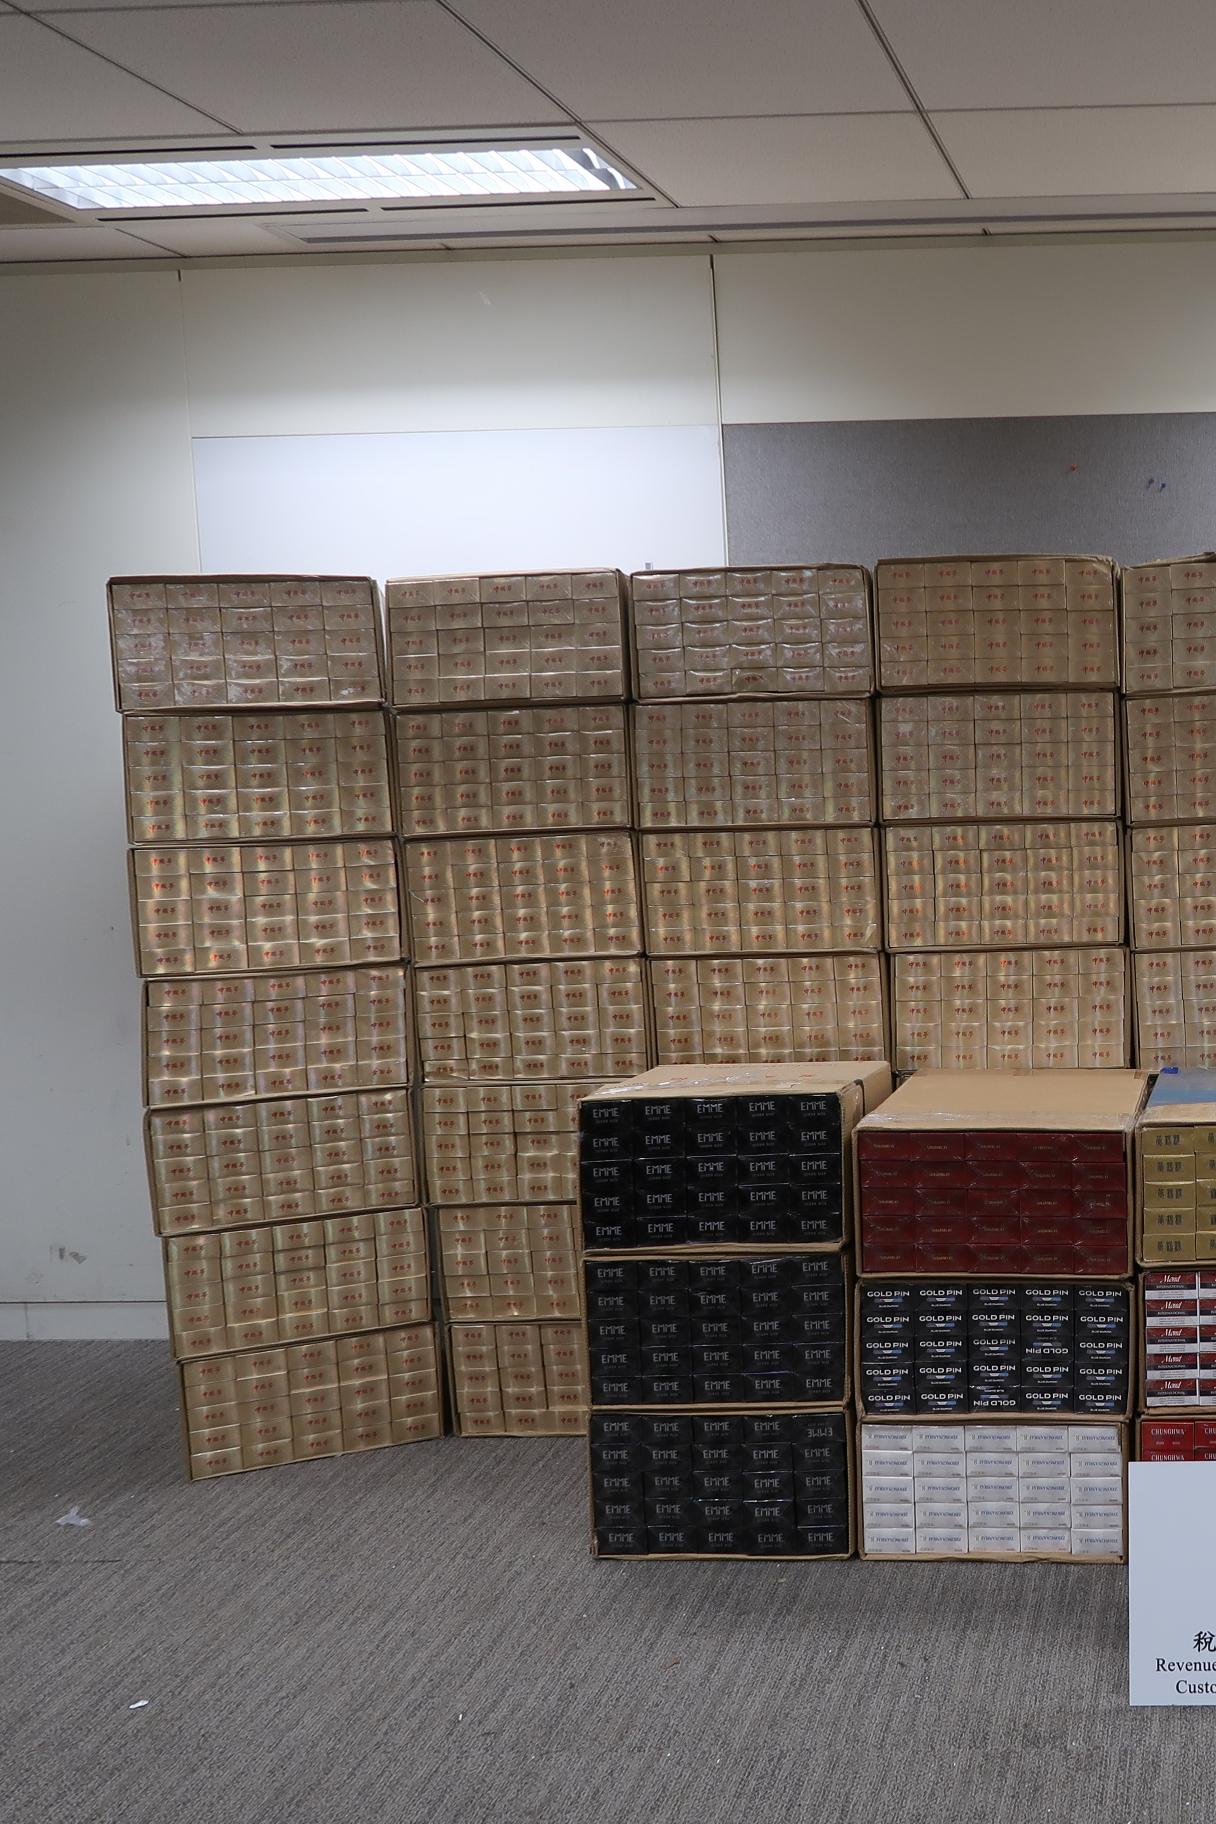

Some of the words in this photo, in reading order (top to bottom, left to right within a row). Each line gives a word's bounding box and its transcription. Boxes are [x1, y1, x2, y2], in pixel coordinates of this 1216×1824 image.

[645, 1104, 672, 1116] EMME
[697, 1102, 724, 1114] EMME
[749, 1100, 776, 1112] EMME
[800, 1099, 827, 1111] EMME
[593, 1107, 620, 1119] EMME
[593, 1136, 620, 1148] EMME
[649, 1265, 676, 1277] EMME
[700, 1265, 727, 1277] EMME
[802, 1260, 829, 1272] EMME
[597, 1267, 624, 1279] EMME
[867, 1290, 893, 1298] GOLD
[919, 1289, 945, 1297] GOLD
[973, 1288, 998, 1296] GOLD
[1053, 1288, 1069, 1296] PIN
[598, 1295, 625, 1307] EMME
[649, 1294, 676, 1306] EMME
[946, 1314, 962, 1322] PIN
[999, 1313, 1015, 1321] PIN
[603, 1420, 630, 1432] EMME
[653, 1421, 680, 1433] EMME
[704, 1420, 731, 1432] EMME
[754, 1420, 781, 1432] EMME
[1151, 1428, 1185, 1436] CHUNGHWA
[602, 1449, 629, 1461] EMME
